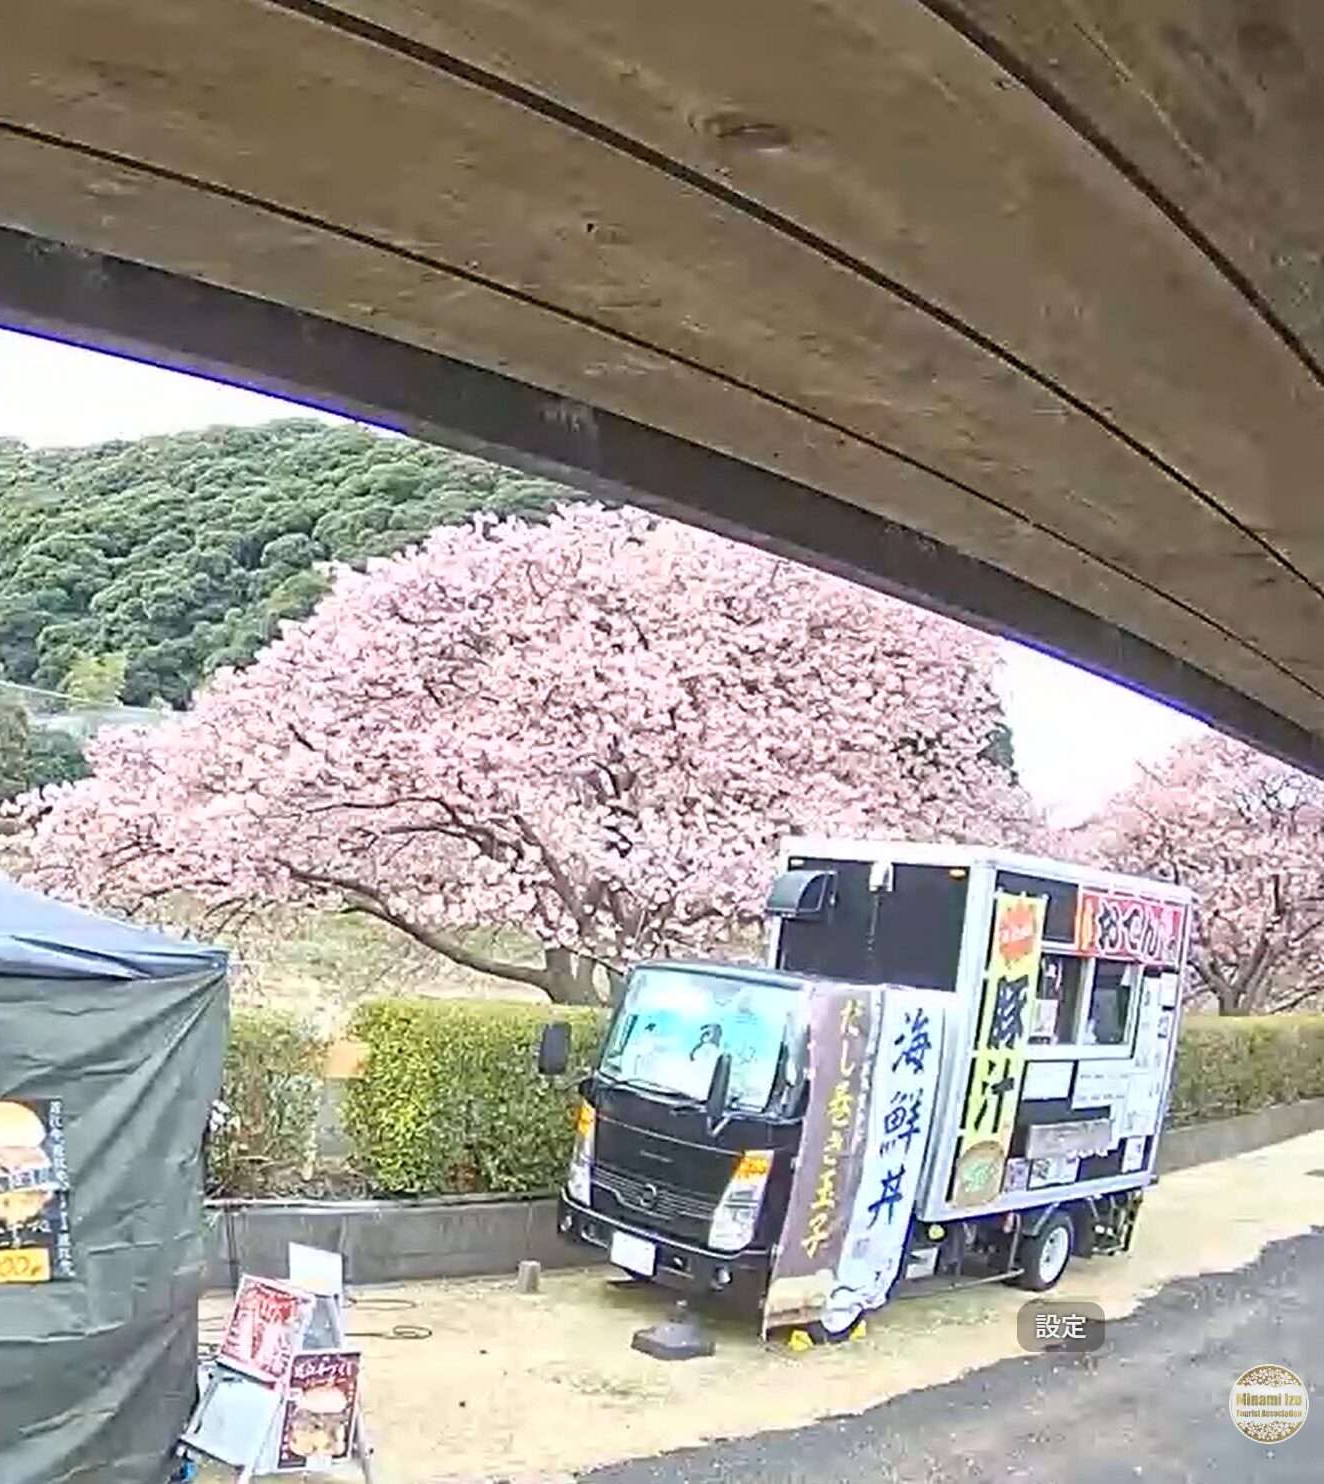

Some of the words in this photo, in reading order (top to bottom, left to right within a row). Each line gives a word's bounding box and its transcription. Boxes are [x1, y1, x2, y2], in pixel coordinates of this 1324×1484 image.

[802, 998, 865, 1260] だし巻き玉子
[867, 1006, 932, 1230] 海鮮丼
[974, 974, 1029, 1134] 豚汁
